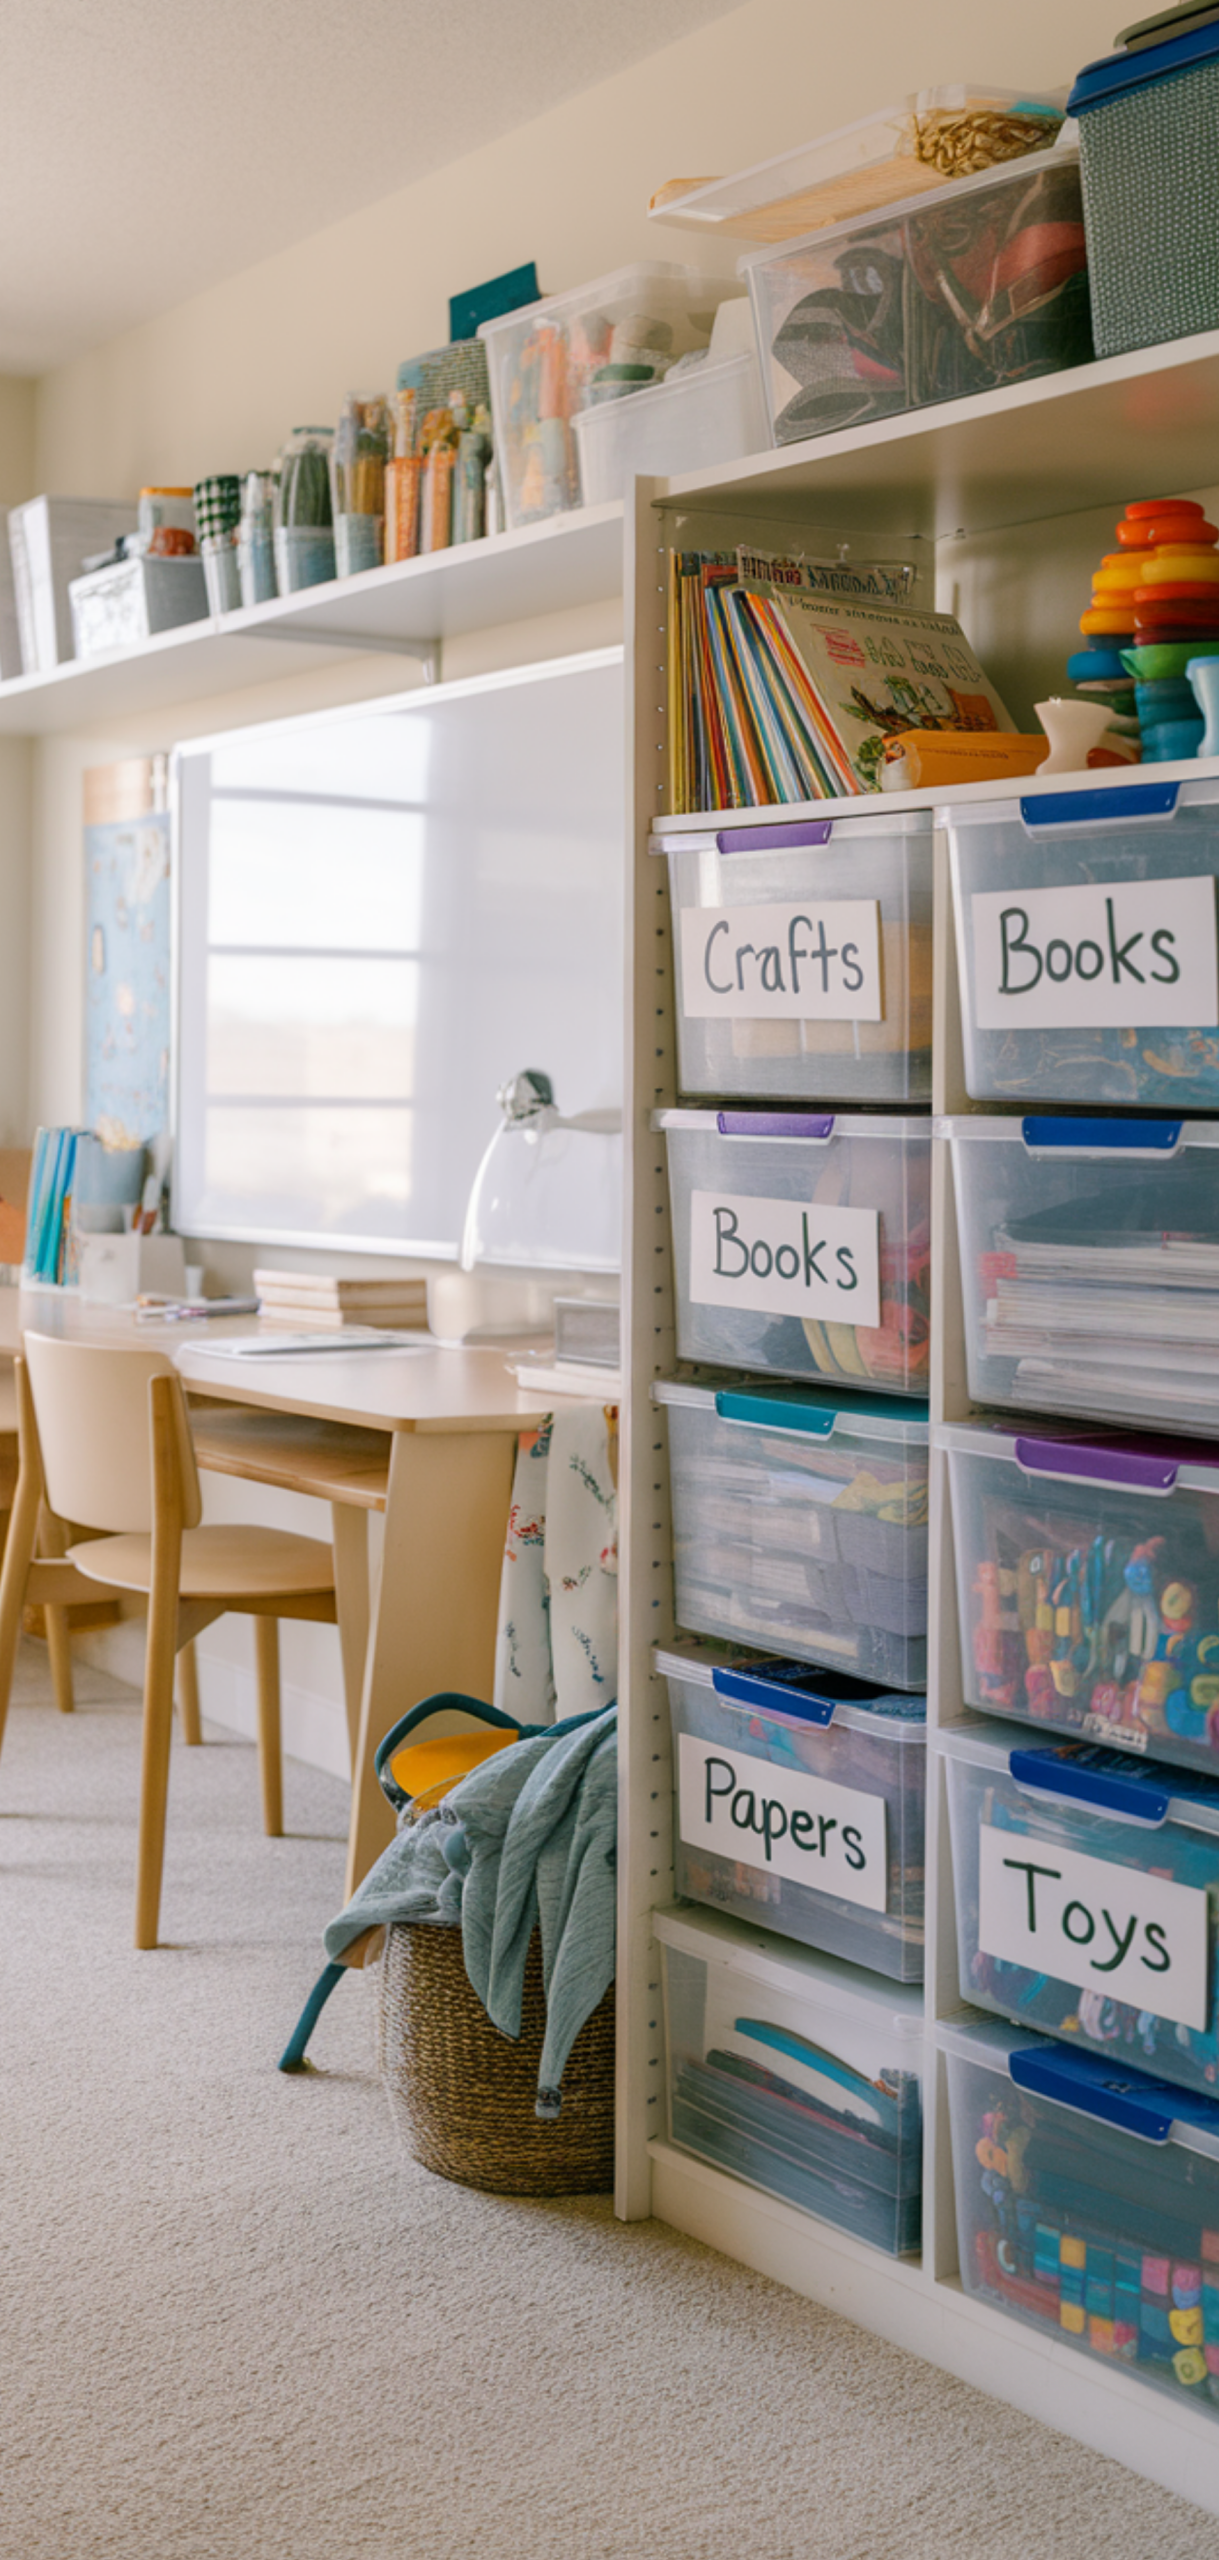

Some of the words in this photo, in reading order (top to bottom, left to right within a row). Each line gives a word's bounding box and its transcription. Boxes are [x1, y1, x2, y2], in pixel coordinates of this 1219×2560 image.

[704, 915, 864, 994] Crafts
[997, 897, 1181, 996] Books
[712, 1206, 858, 1291] Books
[703, 1756, 867, 1871] Papers
[1002, 1858, 1172, 1973] Toys
